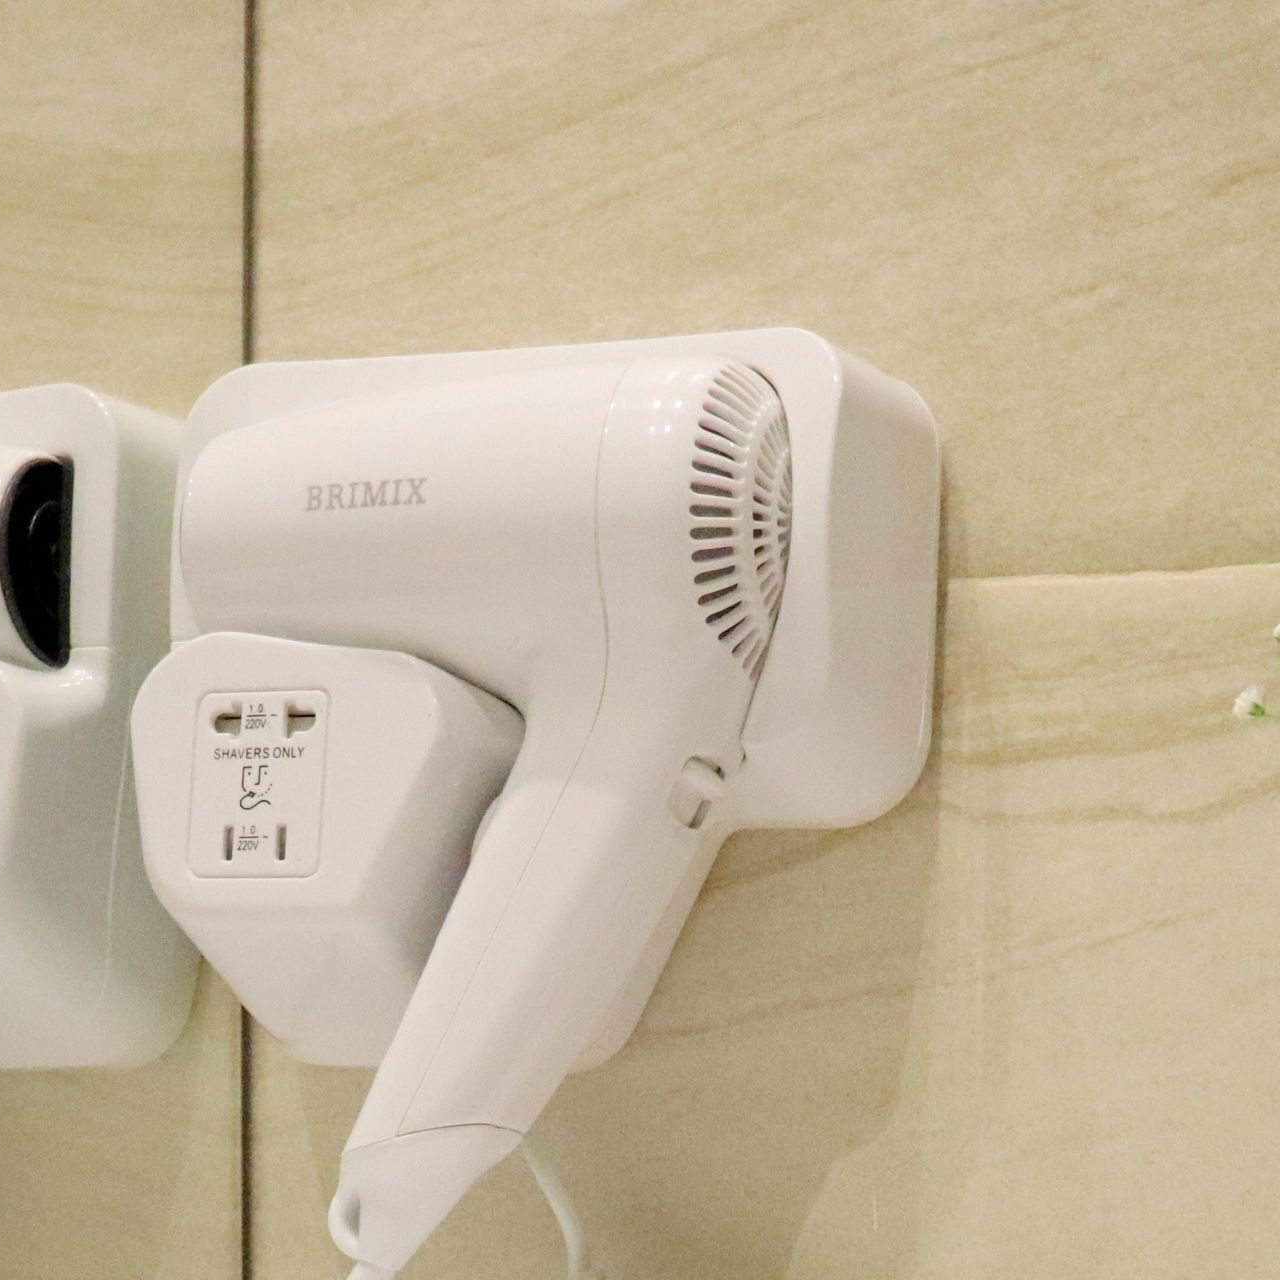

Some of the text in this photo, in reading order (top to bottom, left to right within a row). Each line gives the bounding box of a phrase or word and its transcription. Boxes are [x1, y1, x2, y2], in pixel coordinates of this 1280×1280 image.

[304, 477, 427, 512] BRIMIX
[245, 718, 267, 730] 220V
[214, 746, 305, 761] SHAVERS ONLY
[237, 840, 259, 852] 220V
